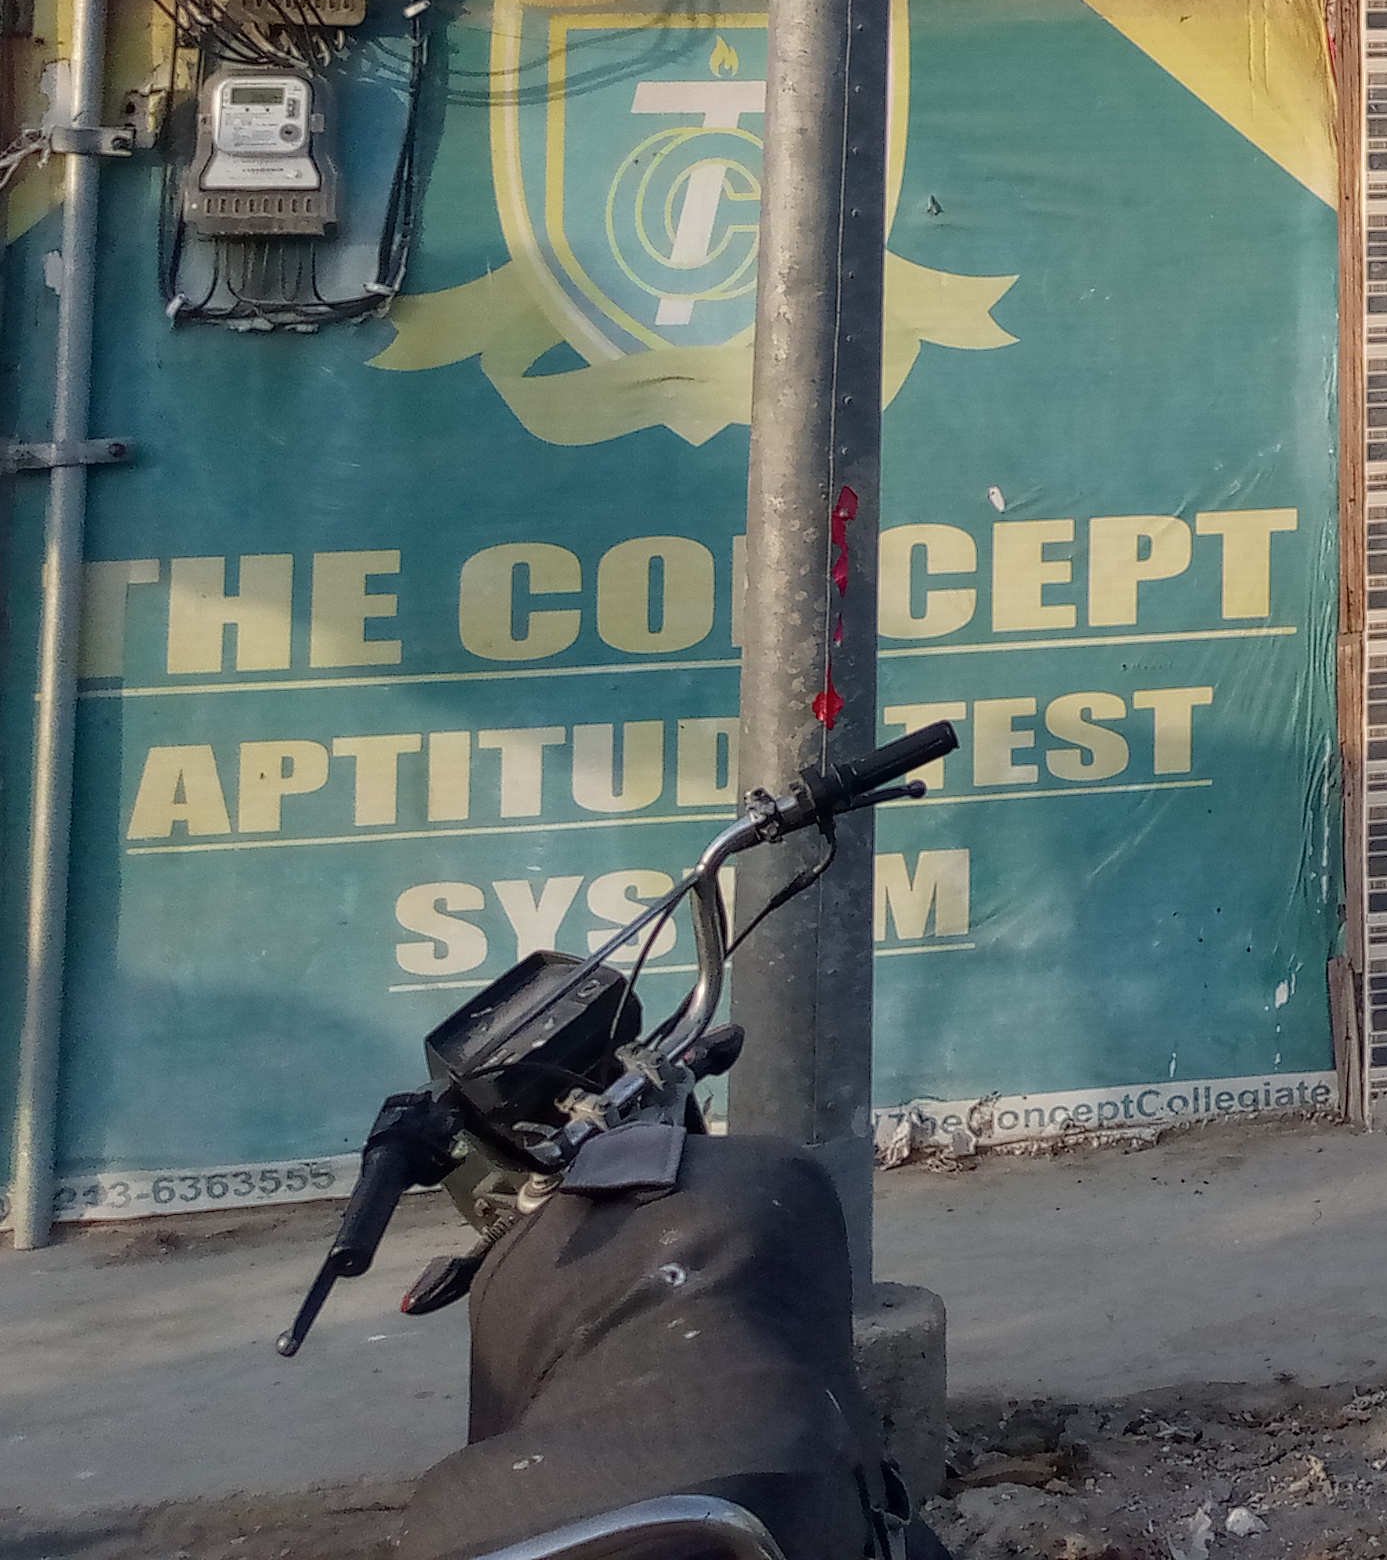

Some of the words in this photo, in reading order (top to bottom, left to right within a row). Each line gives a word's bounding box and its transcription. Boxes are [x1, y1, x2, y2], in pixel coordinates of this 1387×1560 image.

[43, 548, 403, 678] THE
[458, 508, 1298, 662] COCEPT
[126, 716, 739, 840] APTITUD
[883, 686, 1214, 790] TEST
[394, 848, 970, 976] SYSM
